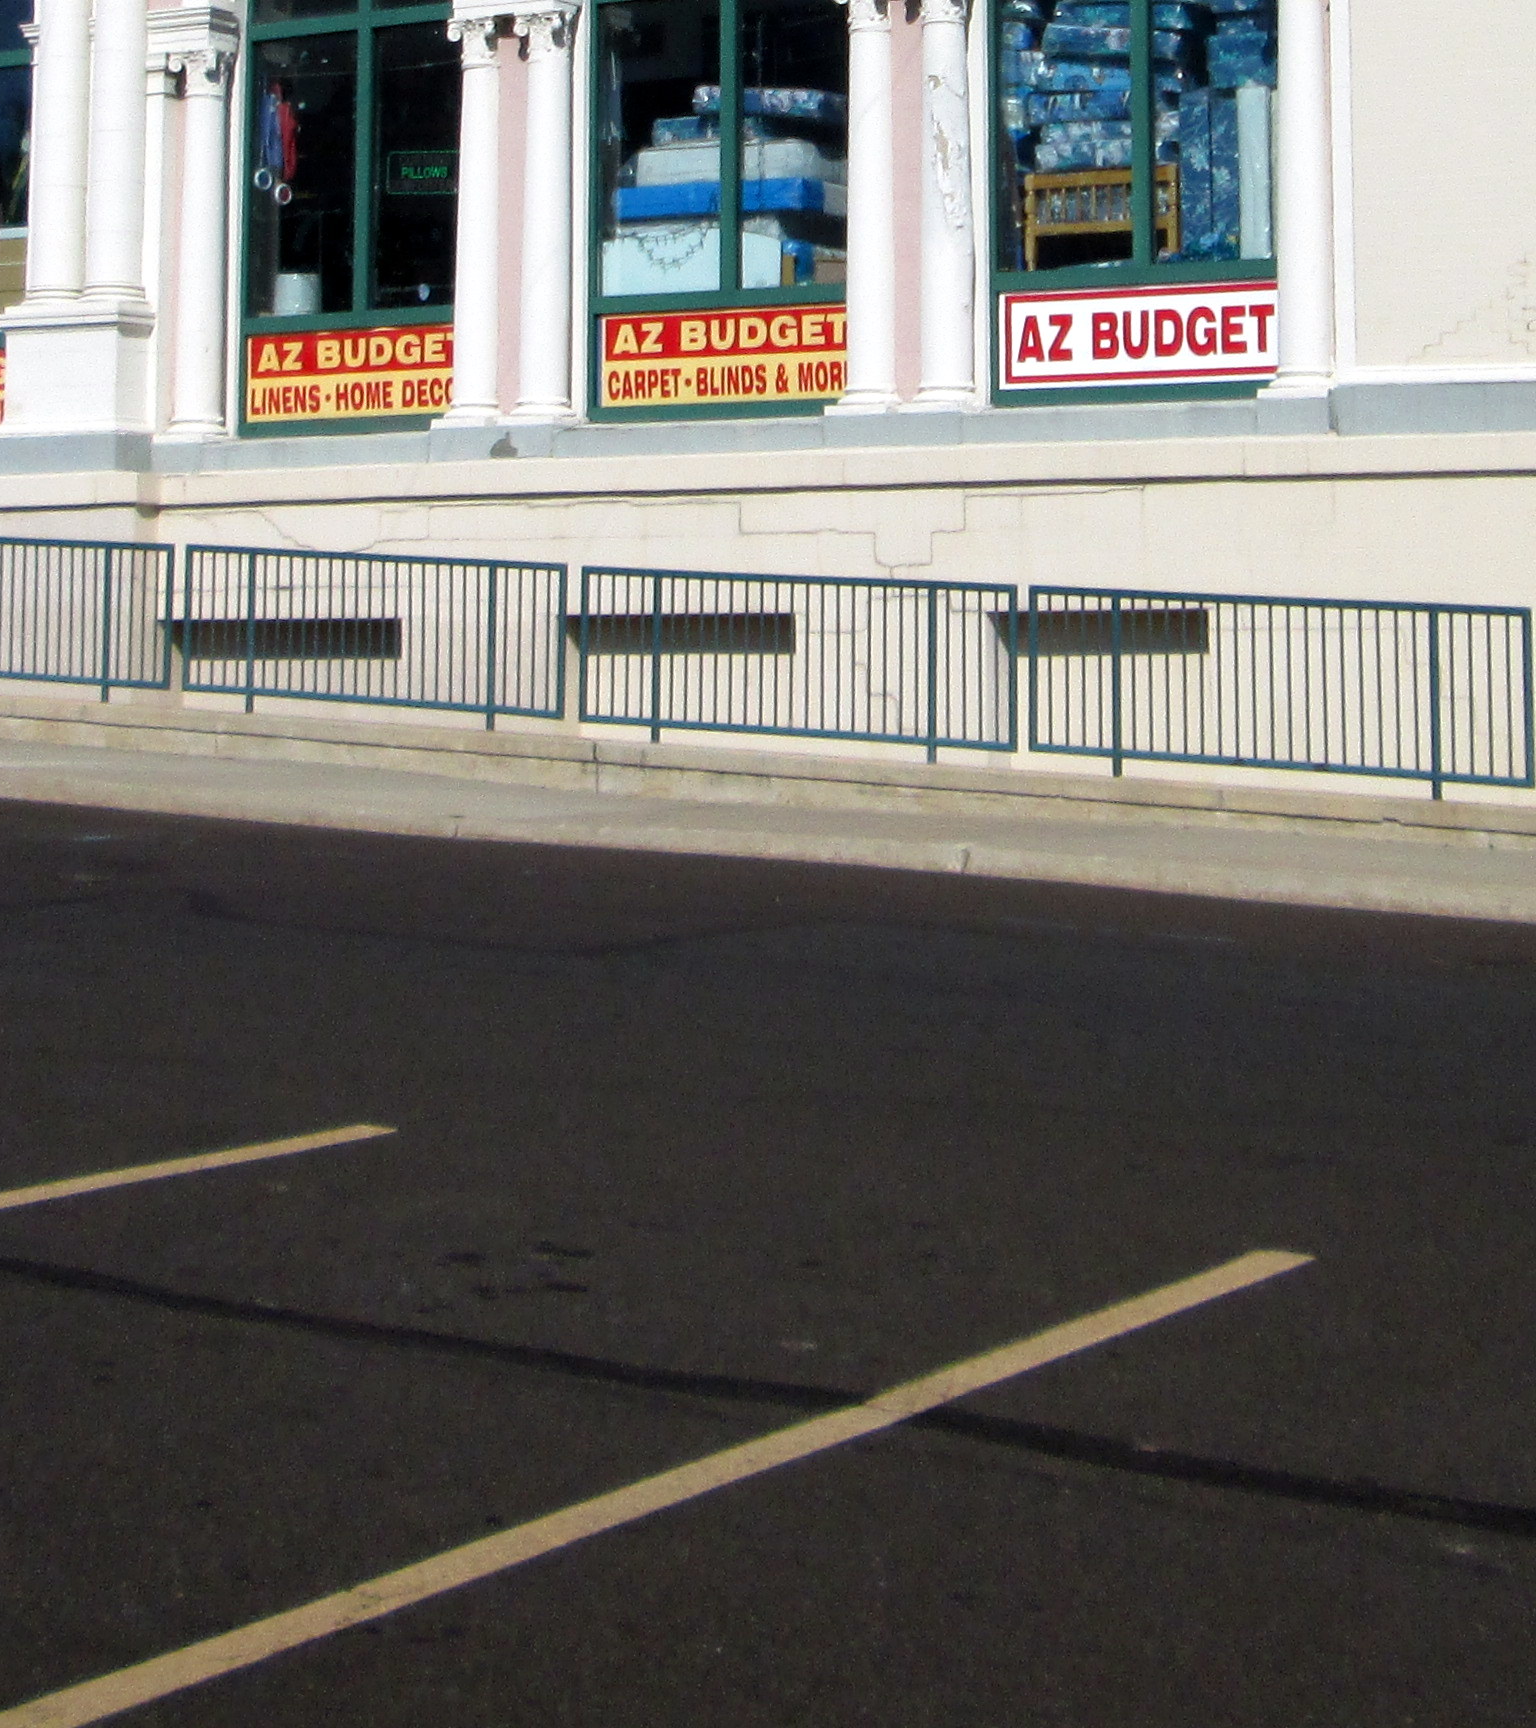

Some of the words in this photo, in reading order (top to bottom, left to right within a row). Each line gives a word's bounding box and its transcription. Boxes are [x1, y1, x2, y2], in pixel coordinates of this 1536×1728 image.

[257, 342, 304, 372] AZ
[317, 332, 453, 369] BUDGE
[612, 323, 664, 355] AZ
[680, 313, 846, 352] BUDGET
[1018, 315, 1073, 363] AZ
[1092, 304, 1275, 360] BUDGET
[251, 384, 321, 415] LINENS
[336, 380, 394, 411] HOME
[608, 368, 681, 401] CARPET
[696, 364, 767, 397] BLINDS
[775, 362, 789, 393] &
[798, 360, 847, 392] MOR
